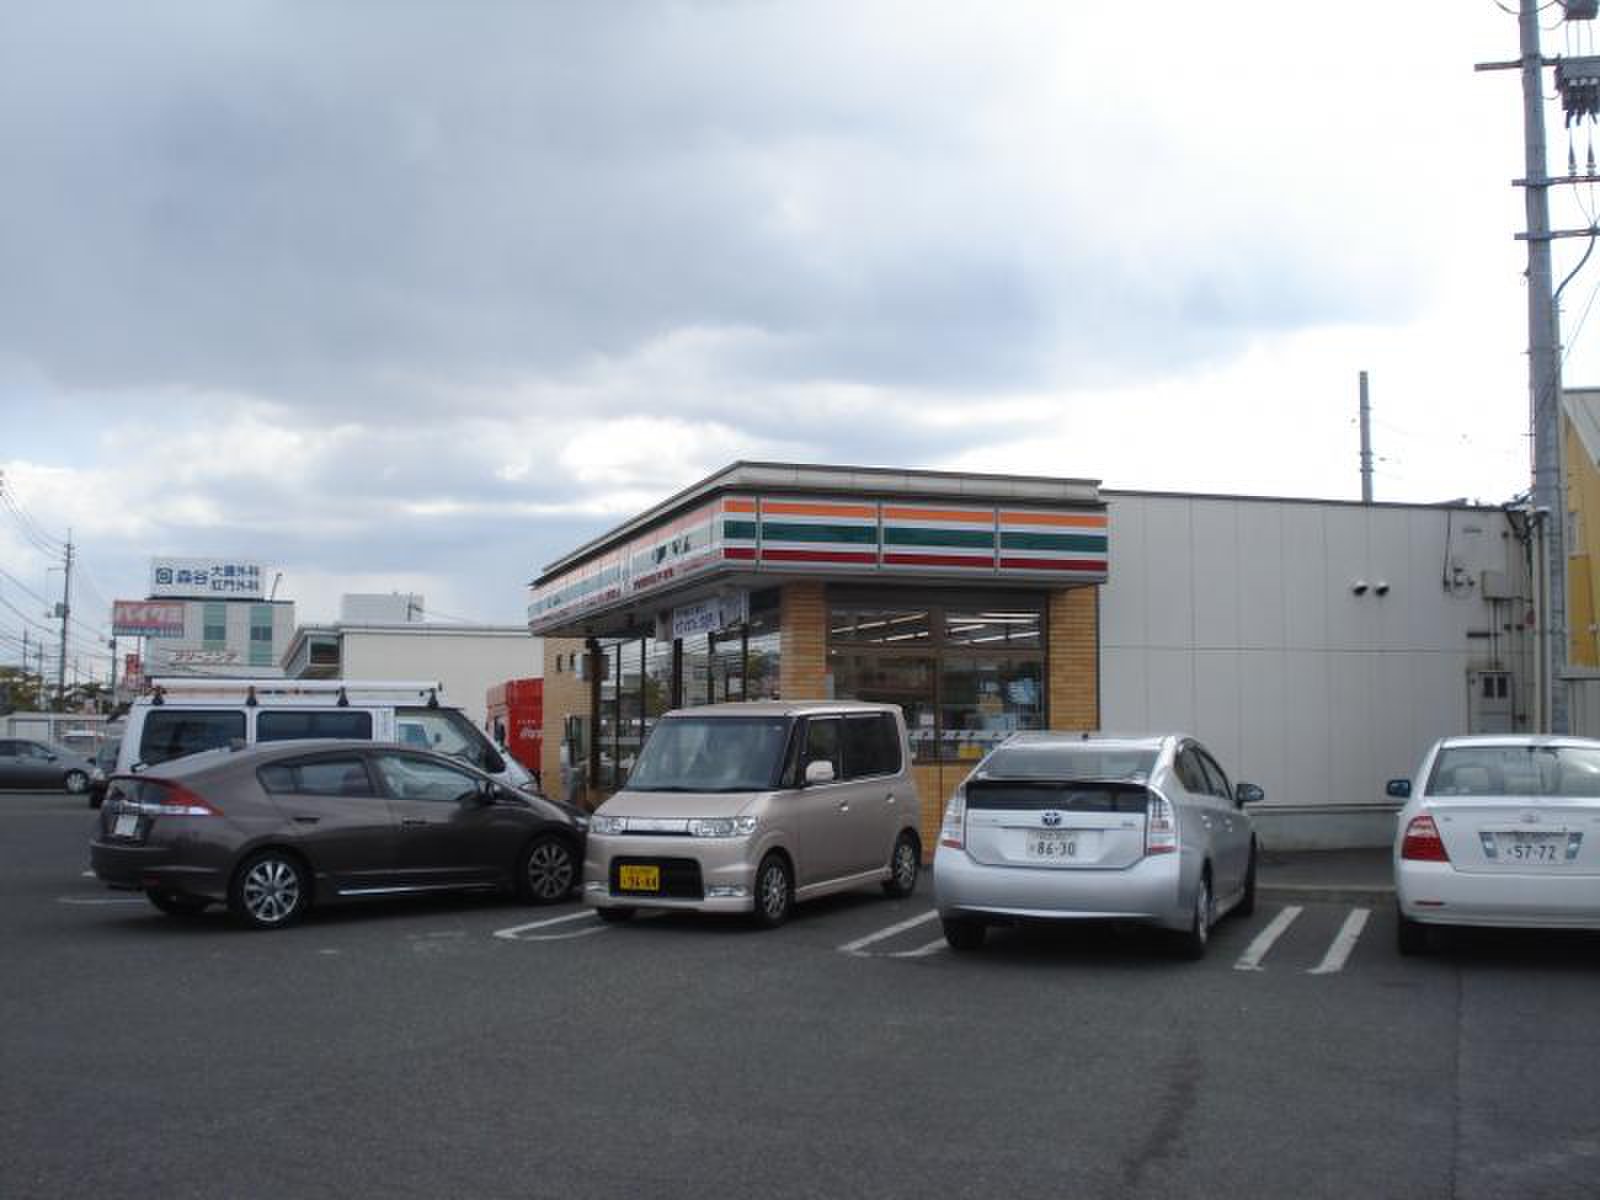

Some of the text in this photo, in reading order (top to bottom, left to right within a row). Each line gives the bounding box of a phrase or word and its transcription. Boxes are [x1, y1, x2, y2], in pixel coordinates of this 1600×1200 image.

[176, 569, 208, 585] 森谷
[1037, 842, 1075, 856] 86-30
[1513, 846, 1556, 860] 57-72
